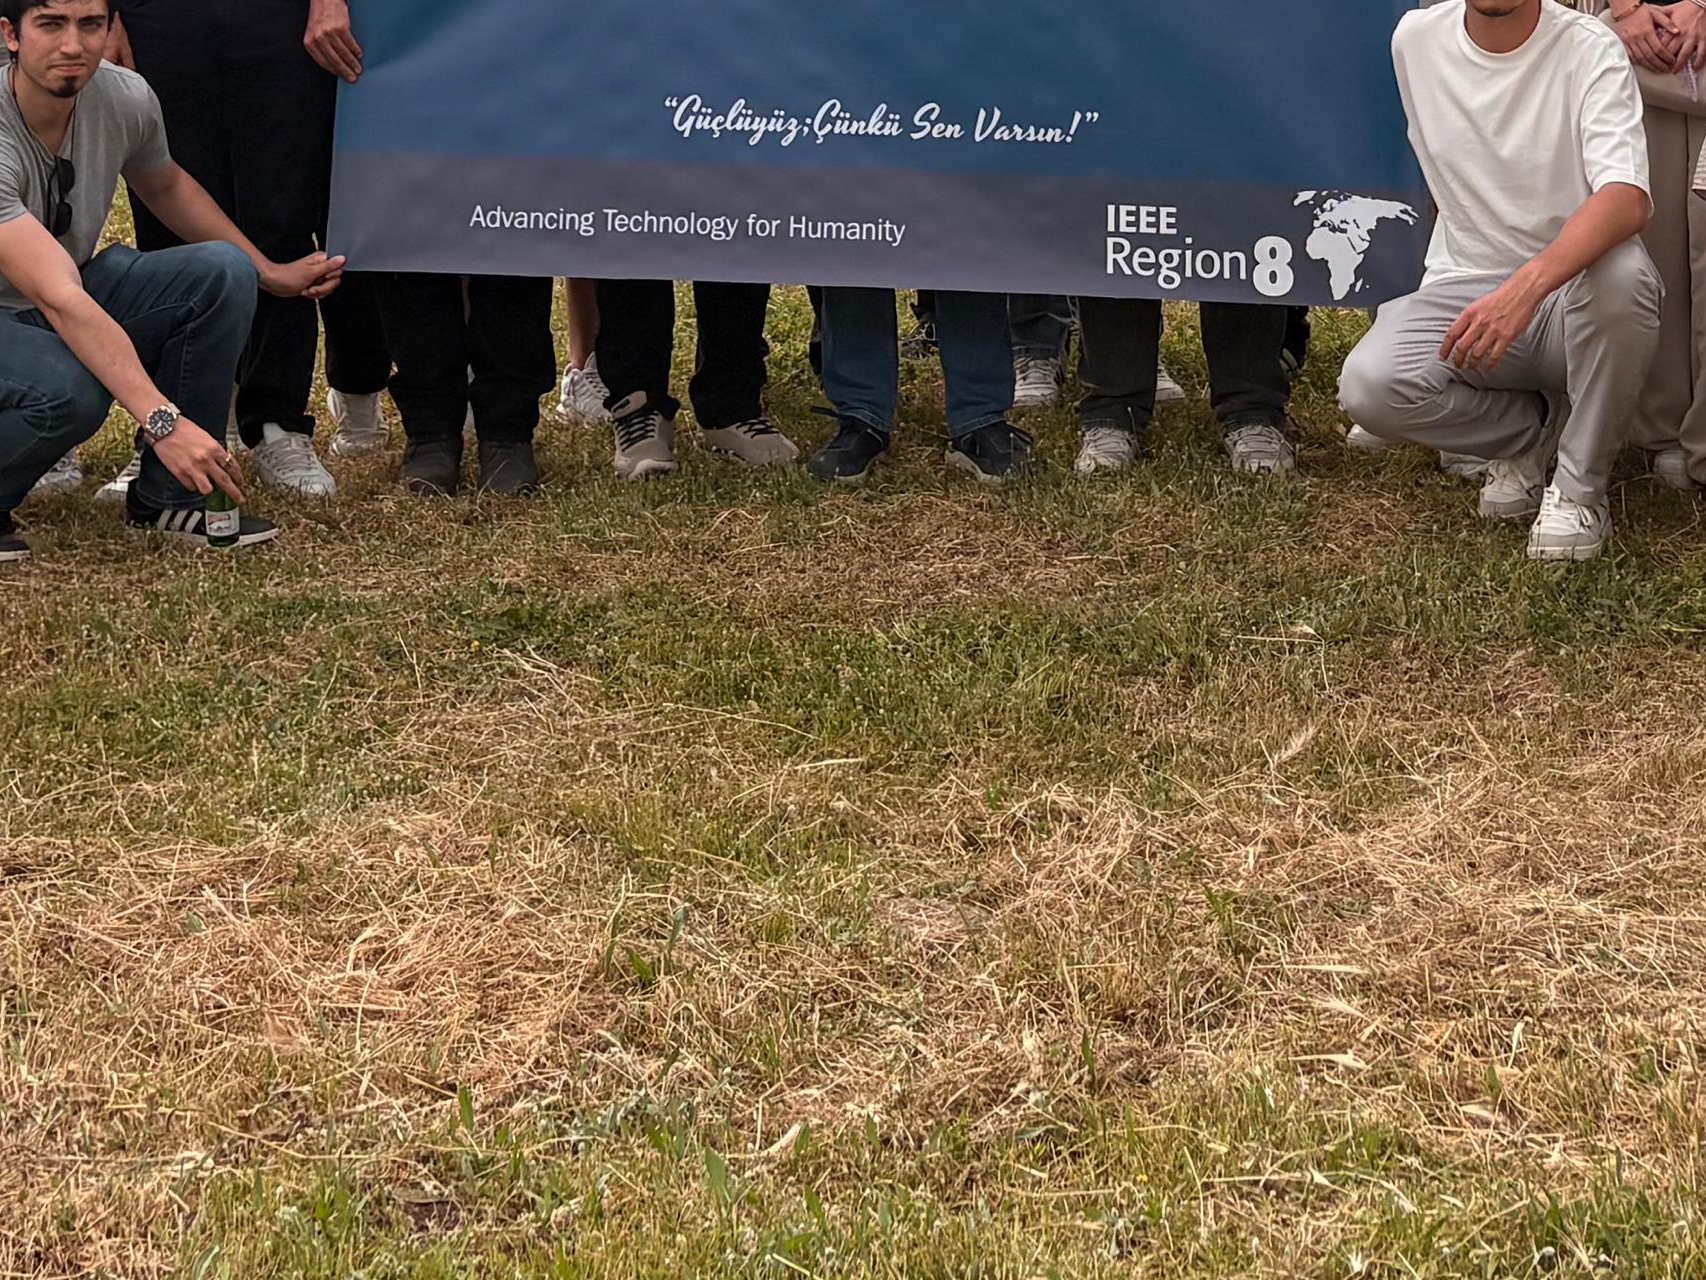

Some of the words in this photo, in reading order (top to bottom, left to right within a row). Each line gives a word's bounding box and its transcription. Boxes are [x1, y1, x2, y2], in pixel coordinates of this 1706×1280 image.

[910, 102, 964, 140] Sen
[470, 205, 595, 236] Advancing
[603, 209, 739, 240] Technology
[747, 214, 780, 238] for
[789, 216, 906, 246] Humanity
[1107, 204, 1177, 235] IEEE
[1106, 236, 1246, 290] Region
[1252, 235, 1294, 297] 8
